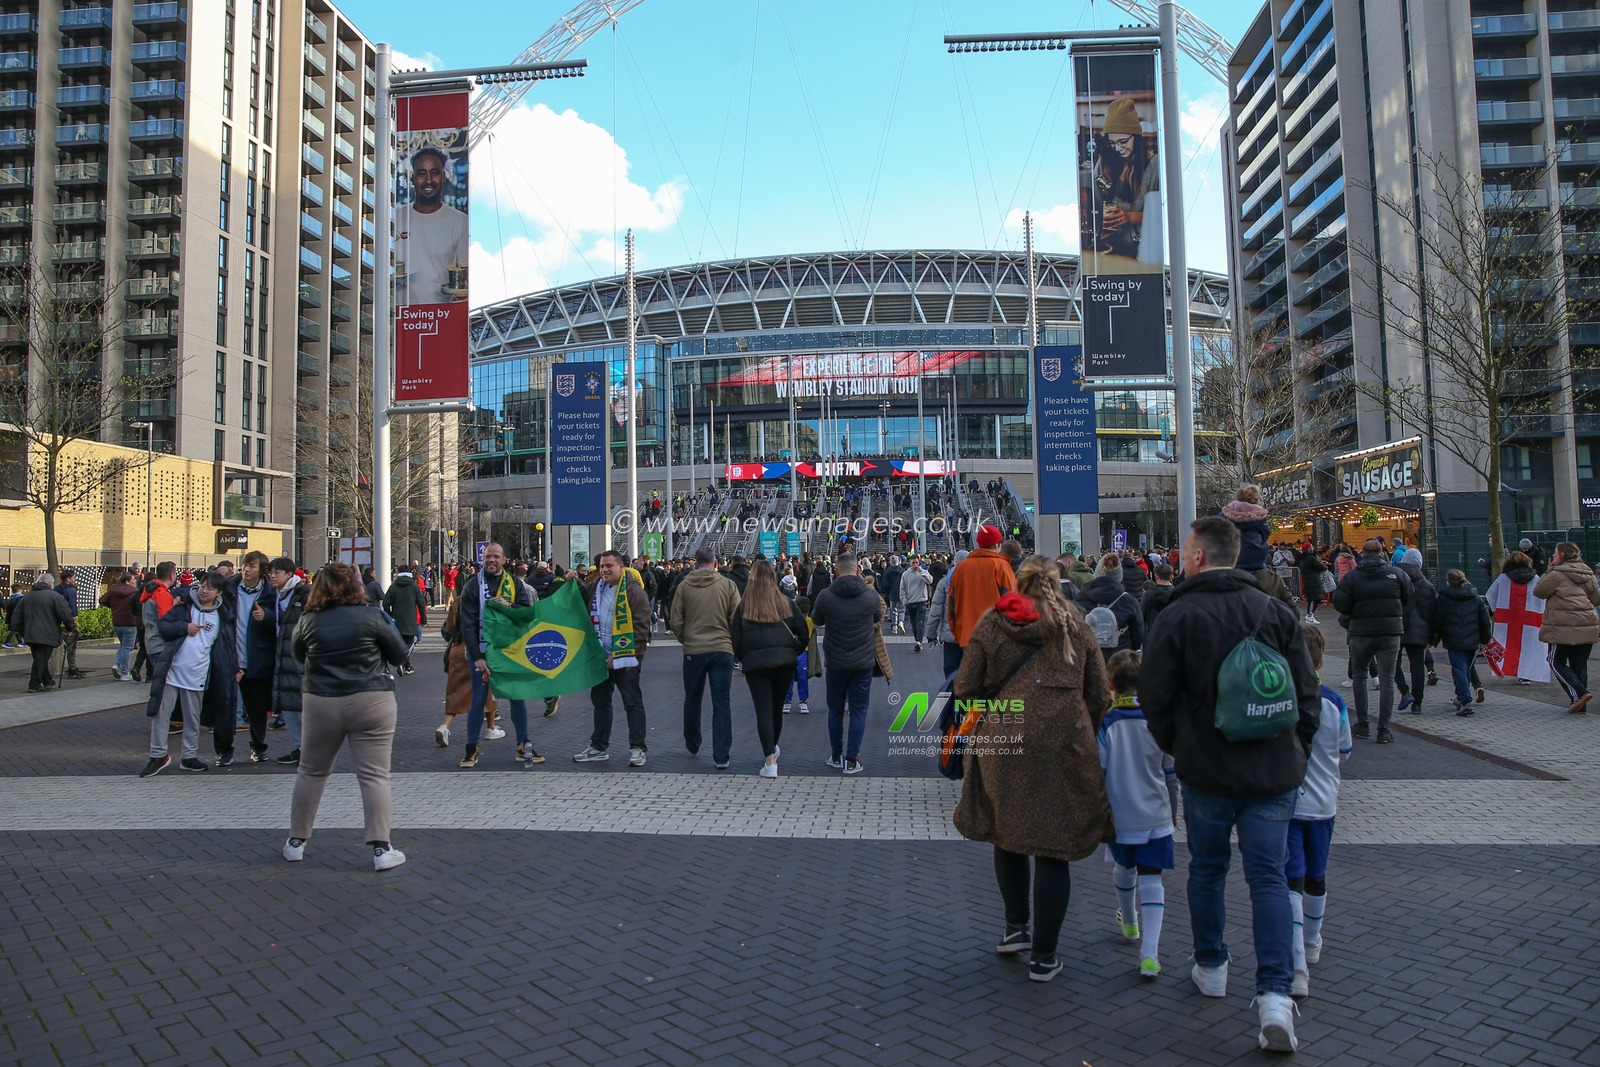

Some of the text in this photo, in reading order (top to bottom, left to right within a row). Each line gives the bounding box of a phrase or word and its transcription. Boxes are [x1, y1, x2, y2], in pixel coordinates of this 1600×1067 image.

[1090, 280, 1142, 291] Swing by
[1091, 292, 1124, 302] today
[403, 309, 450, 319] Swing by
[403, 321, 434, 330] today
[803, 354, 896, 376] EXPERIENCE THE
[776, 378, 832, 398] WEMBLEY
[836, 377, 888, 396] STADIUM
[1044, 430, 1084, 439] inspection
[845, 462, 860, 476] 7PM
[1072, 464, 1092, 472] place
[1342, 460, 1413, 496] SAUSAGE
[1247, 700, 1292, 718] Harpers
